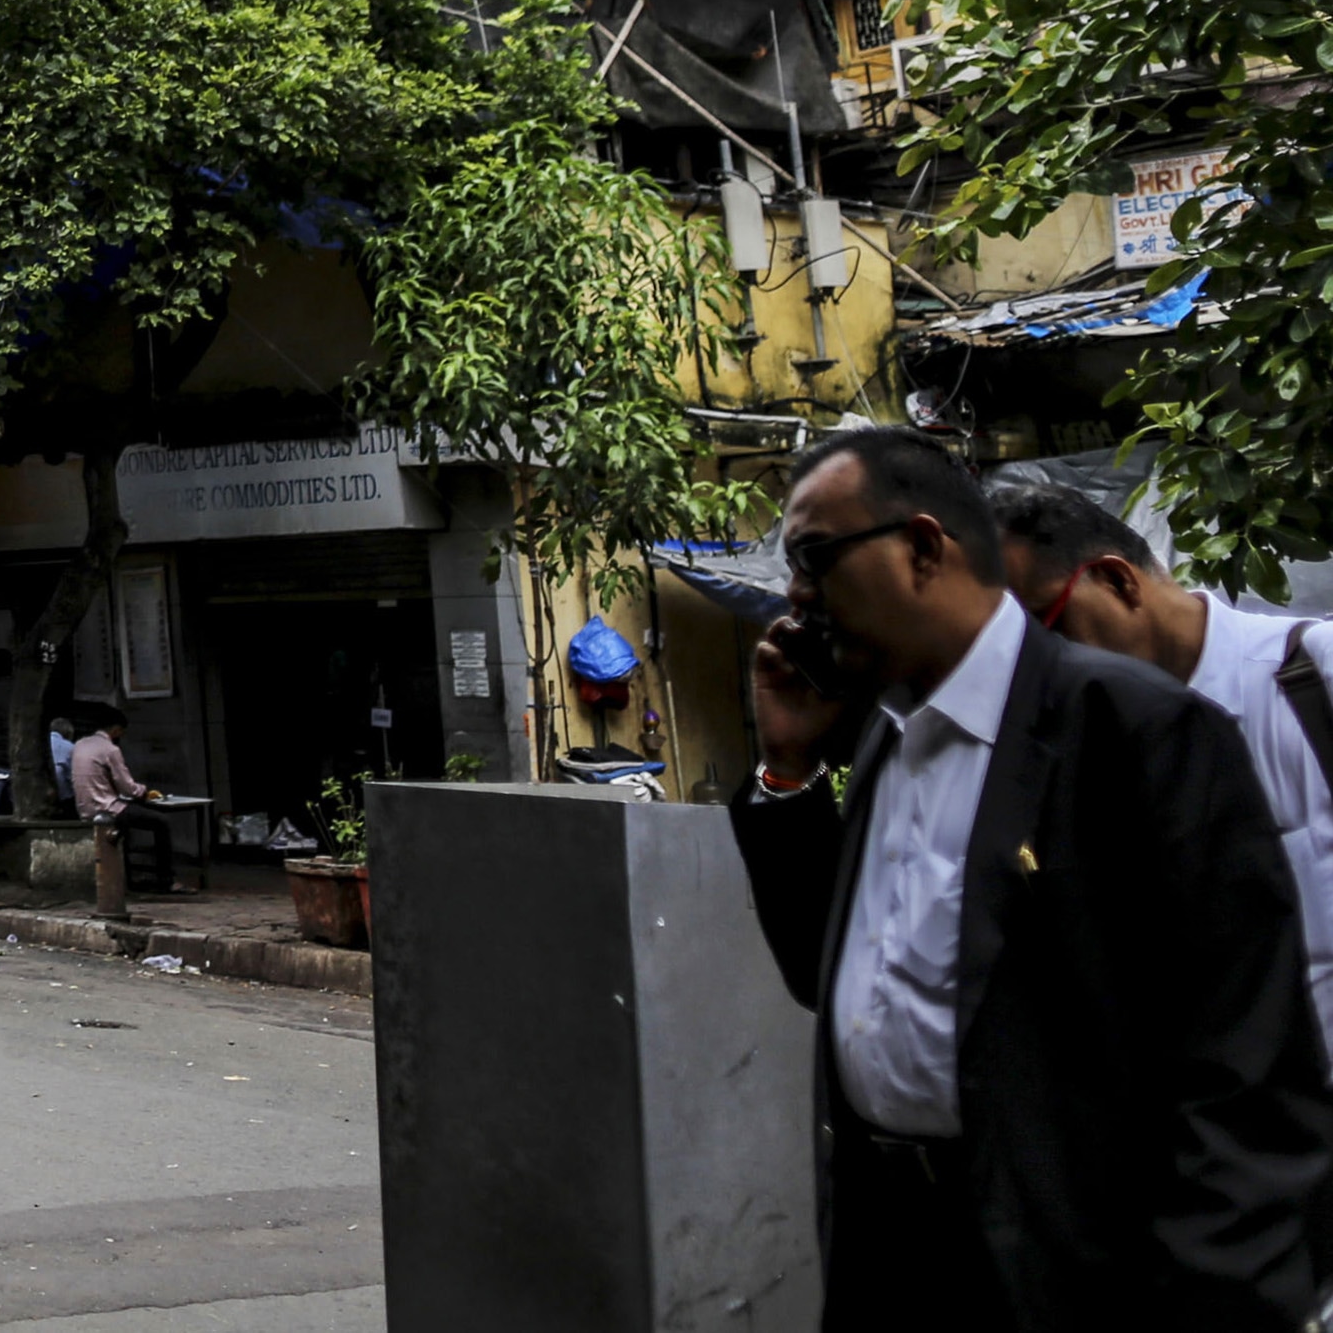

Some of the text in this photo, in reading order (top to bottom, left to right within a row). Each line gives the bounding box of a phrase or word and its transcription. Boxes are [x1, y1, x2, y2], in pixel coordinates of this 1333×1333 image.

[1118, 167, 1183, 198] HRI
[118, 449, 188, 477] JOINDRE
[192, 440, 260, 470] CAPITAL
[264, 437, 353, 464] SERVICES
[358, 426, 397, 455] LTD.
[211, 475, 338, 509] COMMODITIES
[341, 474, 382, 502] LTD.
